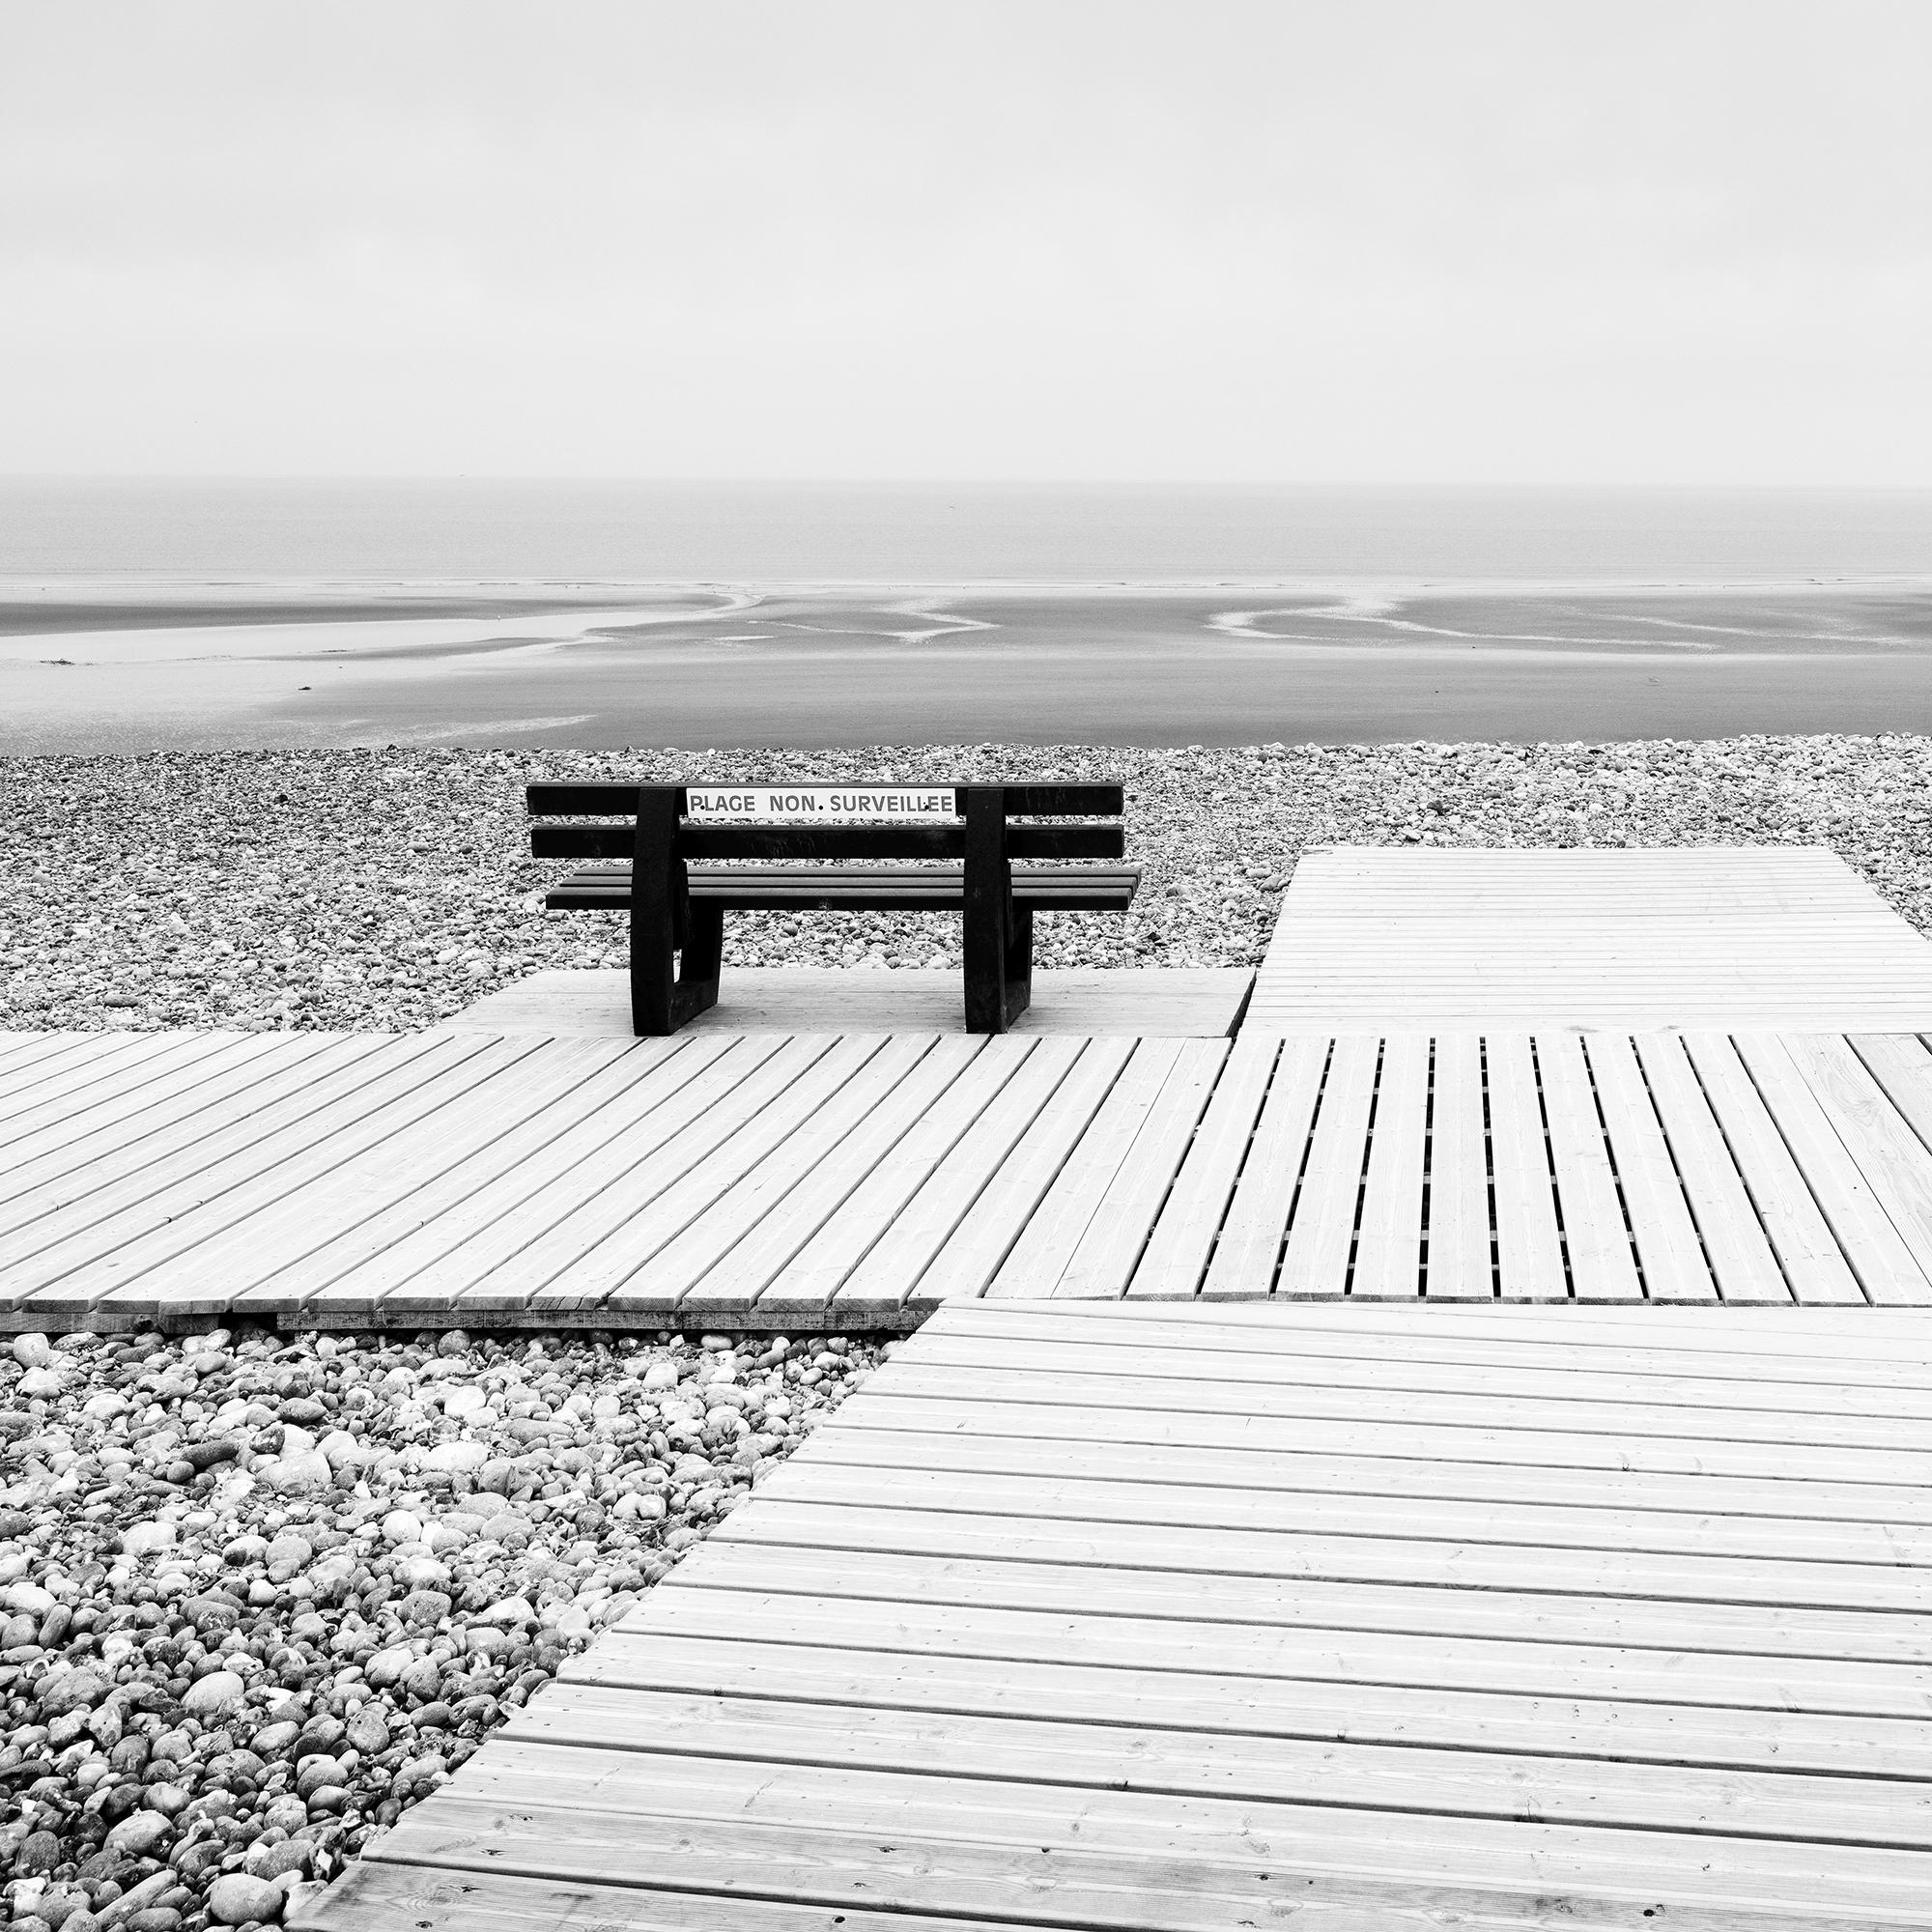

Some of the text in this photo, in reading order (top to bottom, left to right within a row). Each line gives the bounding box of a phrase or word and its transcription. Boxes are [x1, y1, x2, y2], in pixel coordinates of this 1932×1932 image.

[690, 795, 952, 812] PLAGE NON SURVEILLEE
